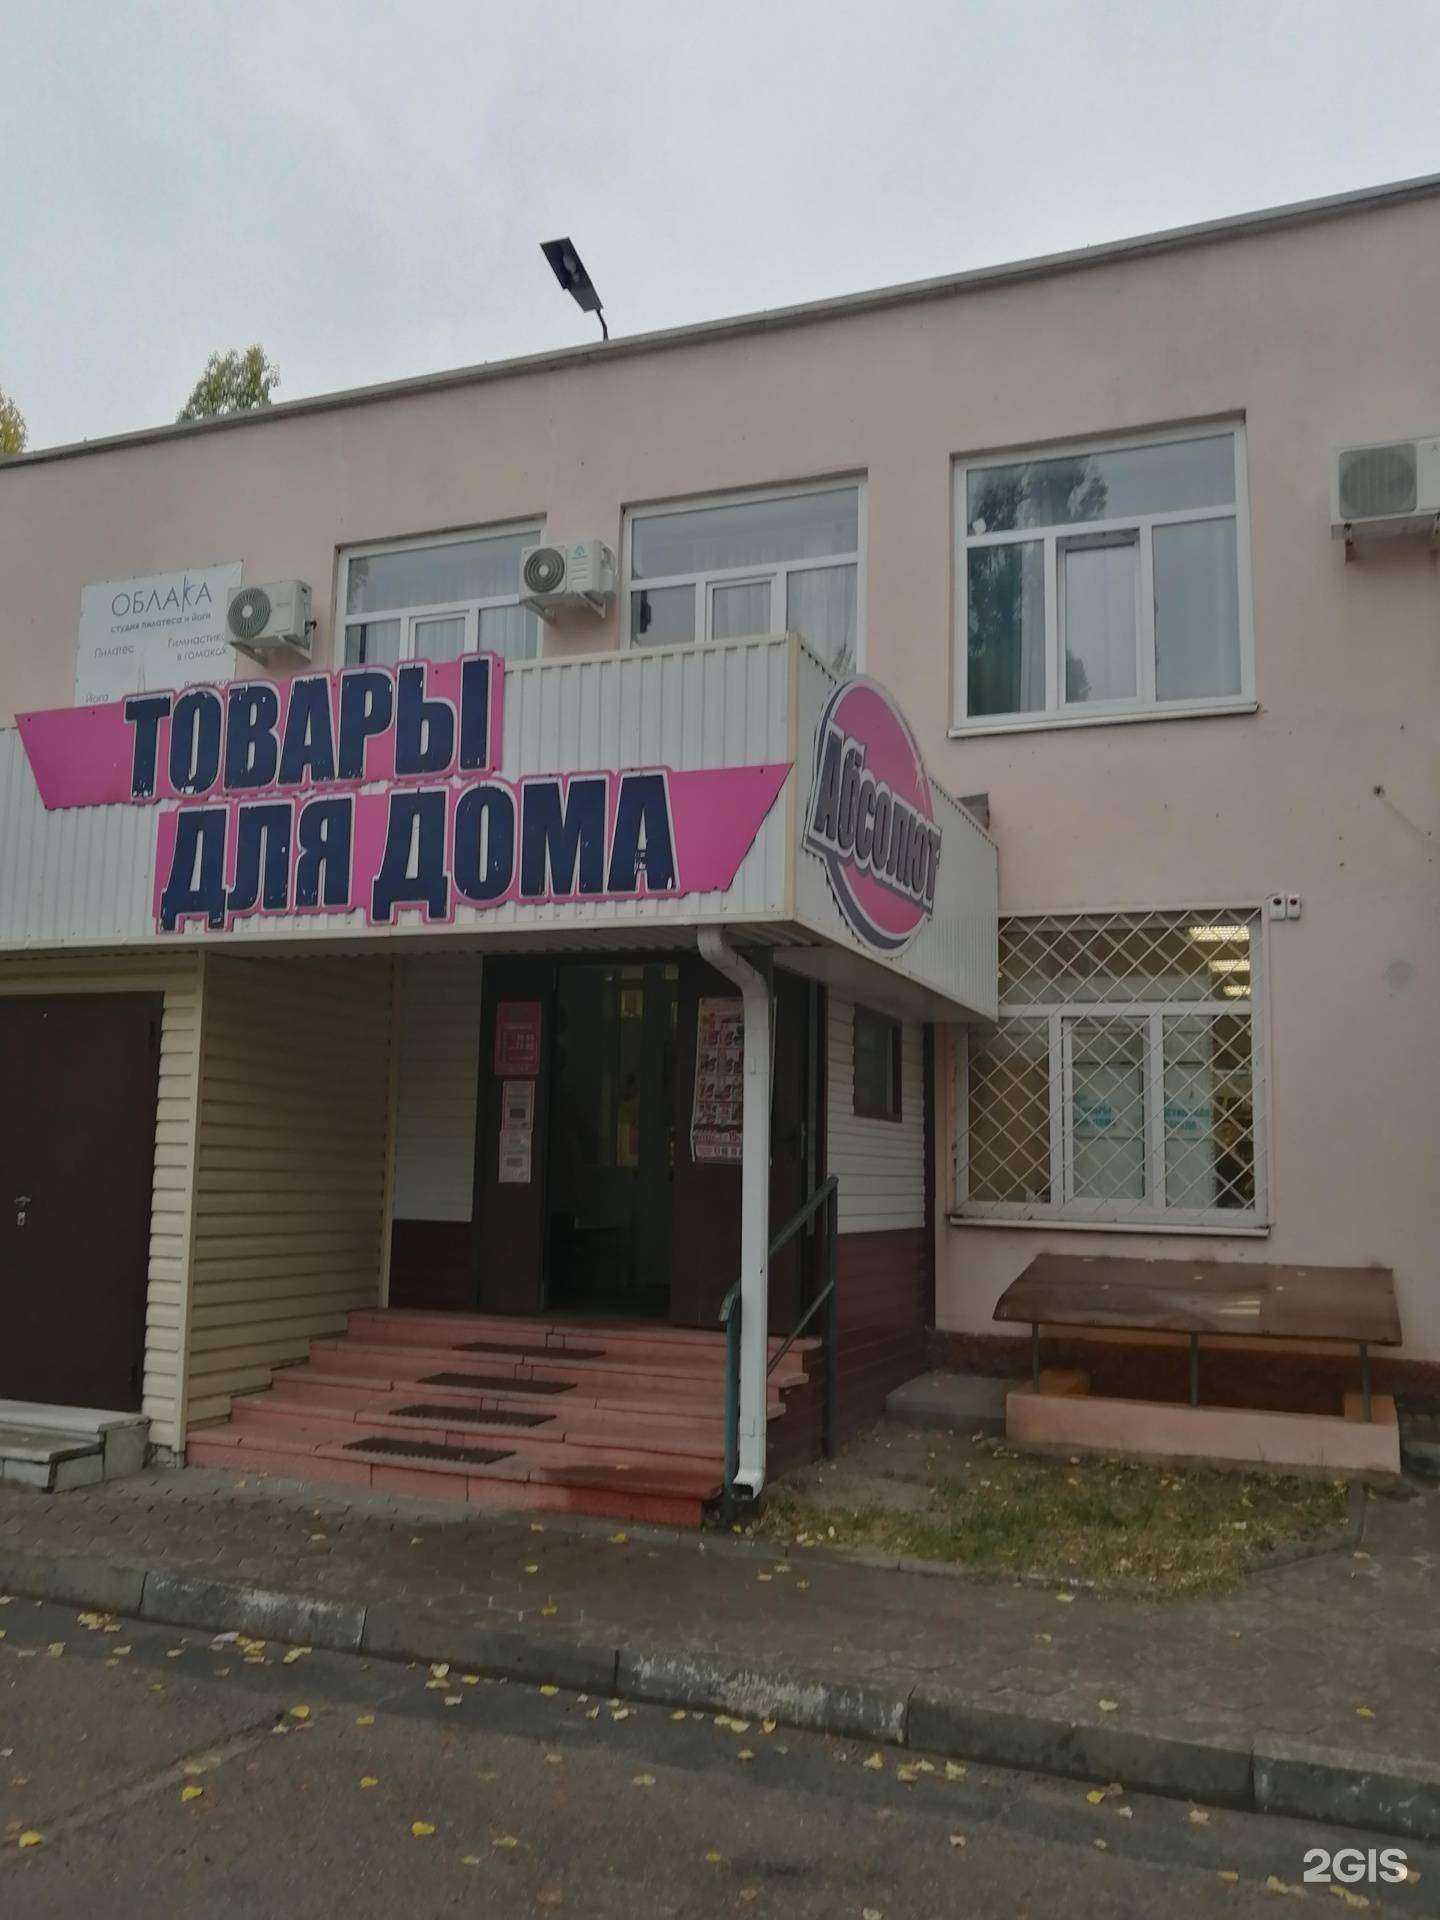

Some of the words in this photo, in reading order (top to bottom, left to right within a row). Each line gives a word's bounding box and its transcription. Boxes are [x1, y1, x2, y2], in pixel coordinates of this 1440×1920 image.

[111, 576, 212, 617] ОБЛАКА
[111, 622, 140, 633] студия
[142, 616, 183, 629] пилатеса
[192, 611, 212, 622] йоги
[95, 645, 135, 659] Пилатес
[125, 656, 488, 798] ТОВАРЫ
[160, 797, 354, 931] ДЛЯ
[371, 774, 677, 922] ДОМА
